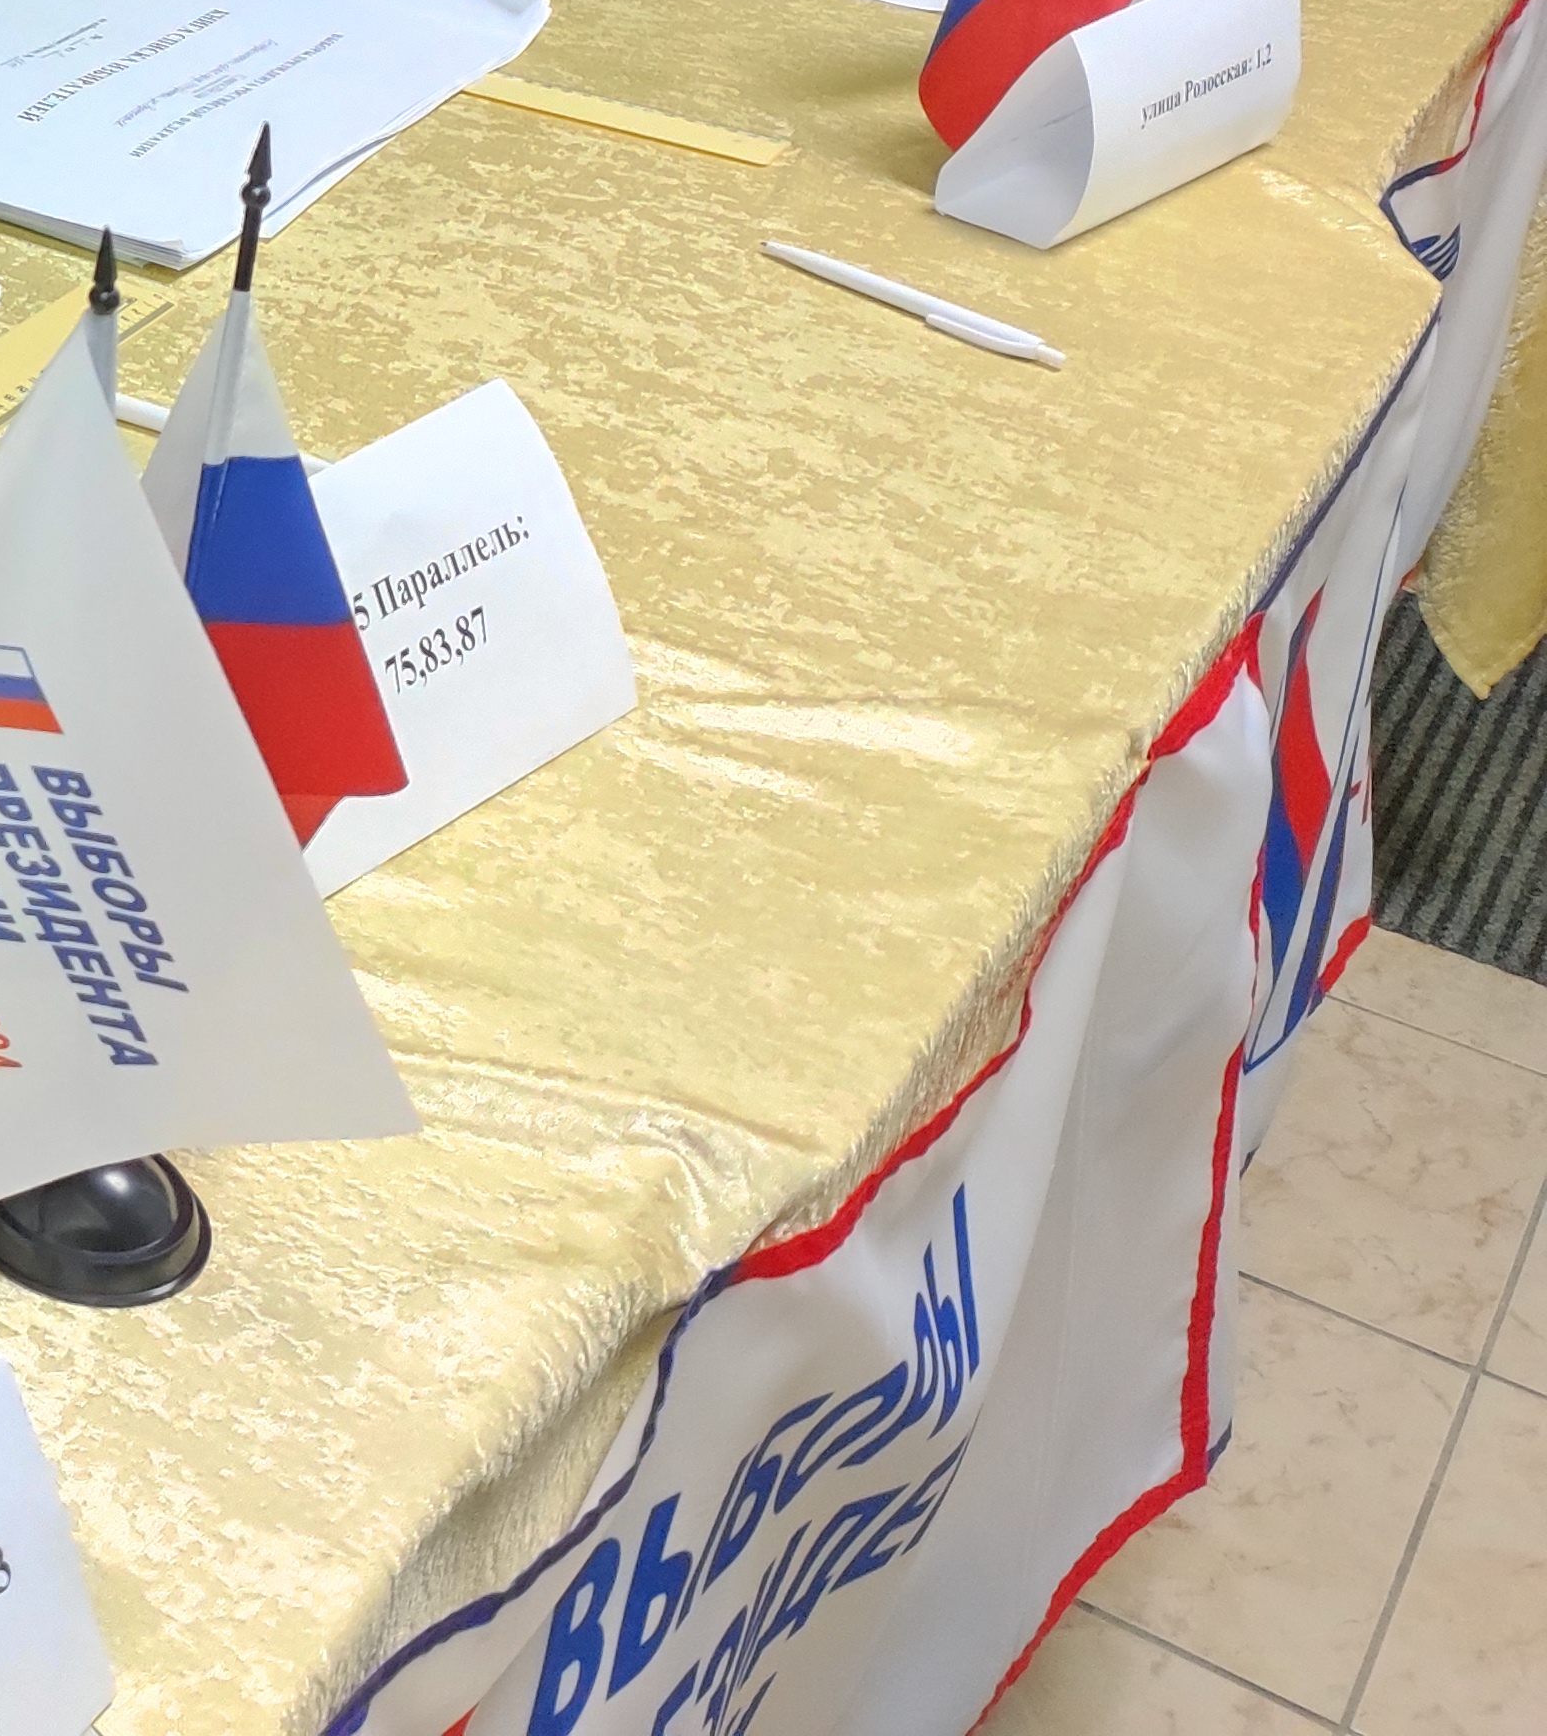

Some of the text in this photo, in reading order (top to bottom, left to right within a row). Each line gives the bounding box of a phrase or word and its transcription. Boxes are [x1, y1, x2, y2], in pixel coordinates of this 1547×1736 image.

[1141, 91, 1181, 130] улица
[1184, 58, 1253, 103] Родосская:
[370, 515, 530, 620] Параллель:
[384, 605, 488, 695] 75,83,87
[32, 764, 189, 994] ВЫБОРЫ
[526, 1181, 980, 1736] ВЫБОРЫ
